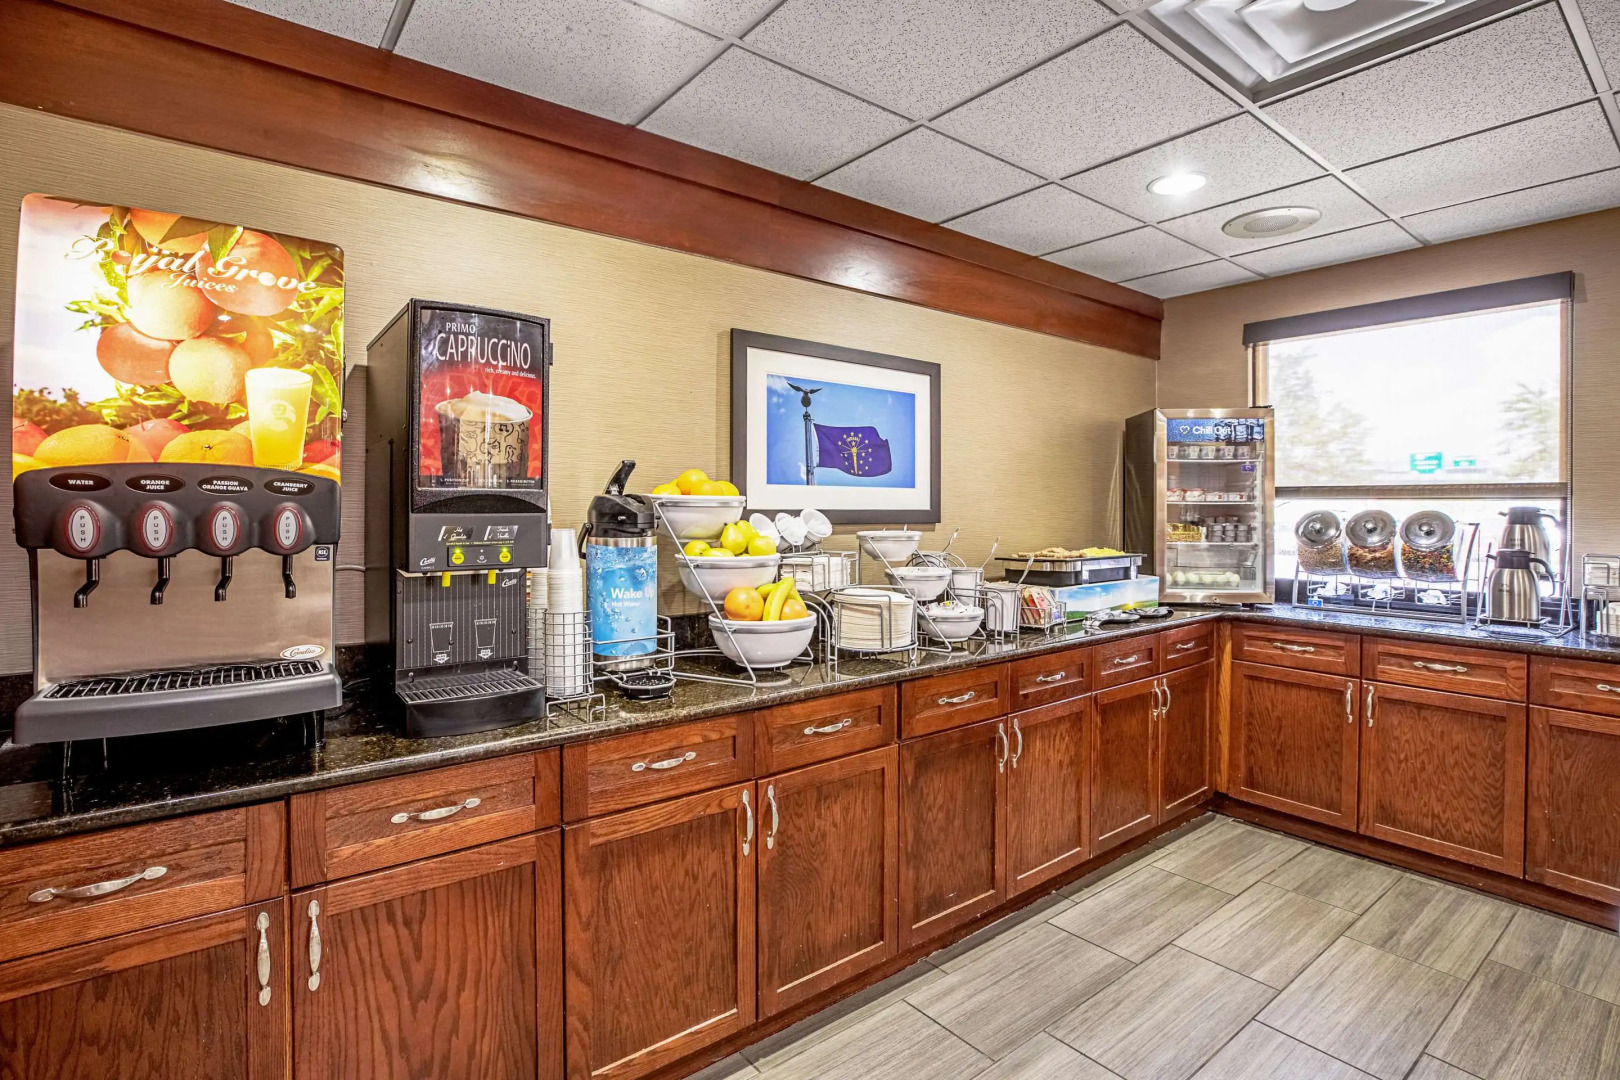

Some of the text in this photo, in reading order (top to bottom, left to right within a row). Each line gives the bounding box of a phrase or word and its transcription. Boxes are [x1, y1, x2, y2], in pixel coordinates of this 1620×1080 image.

[207, 256, 319, 293] Grove
[161, 273, 237, 294] Juices
[445, 322, 476, 334] PRIMO
[1192, 425, 1232, 435] Chill Out
[610, 587, 643, 599] Wake
